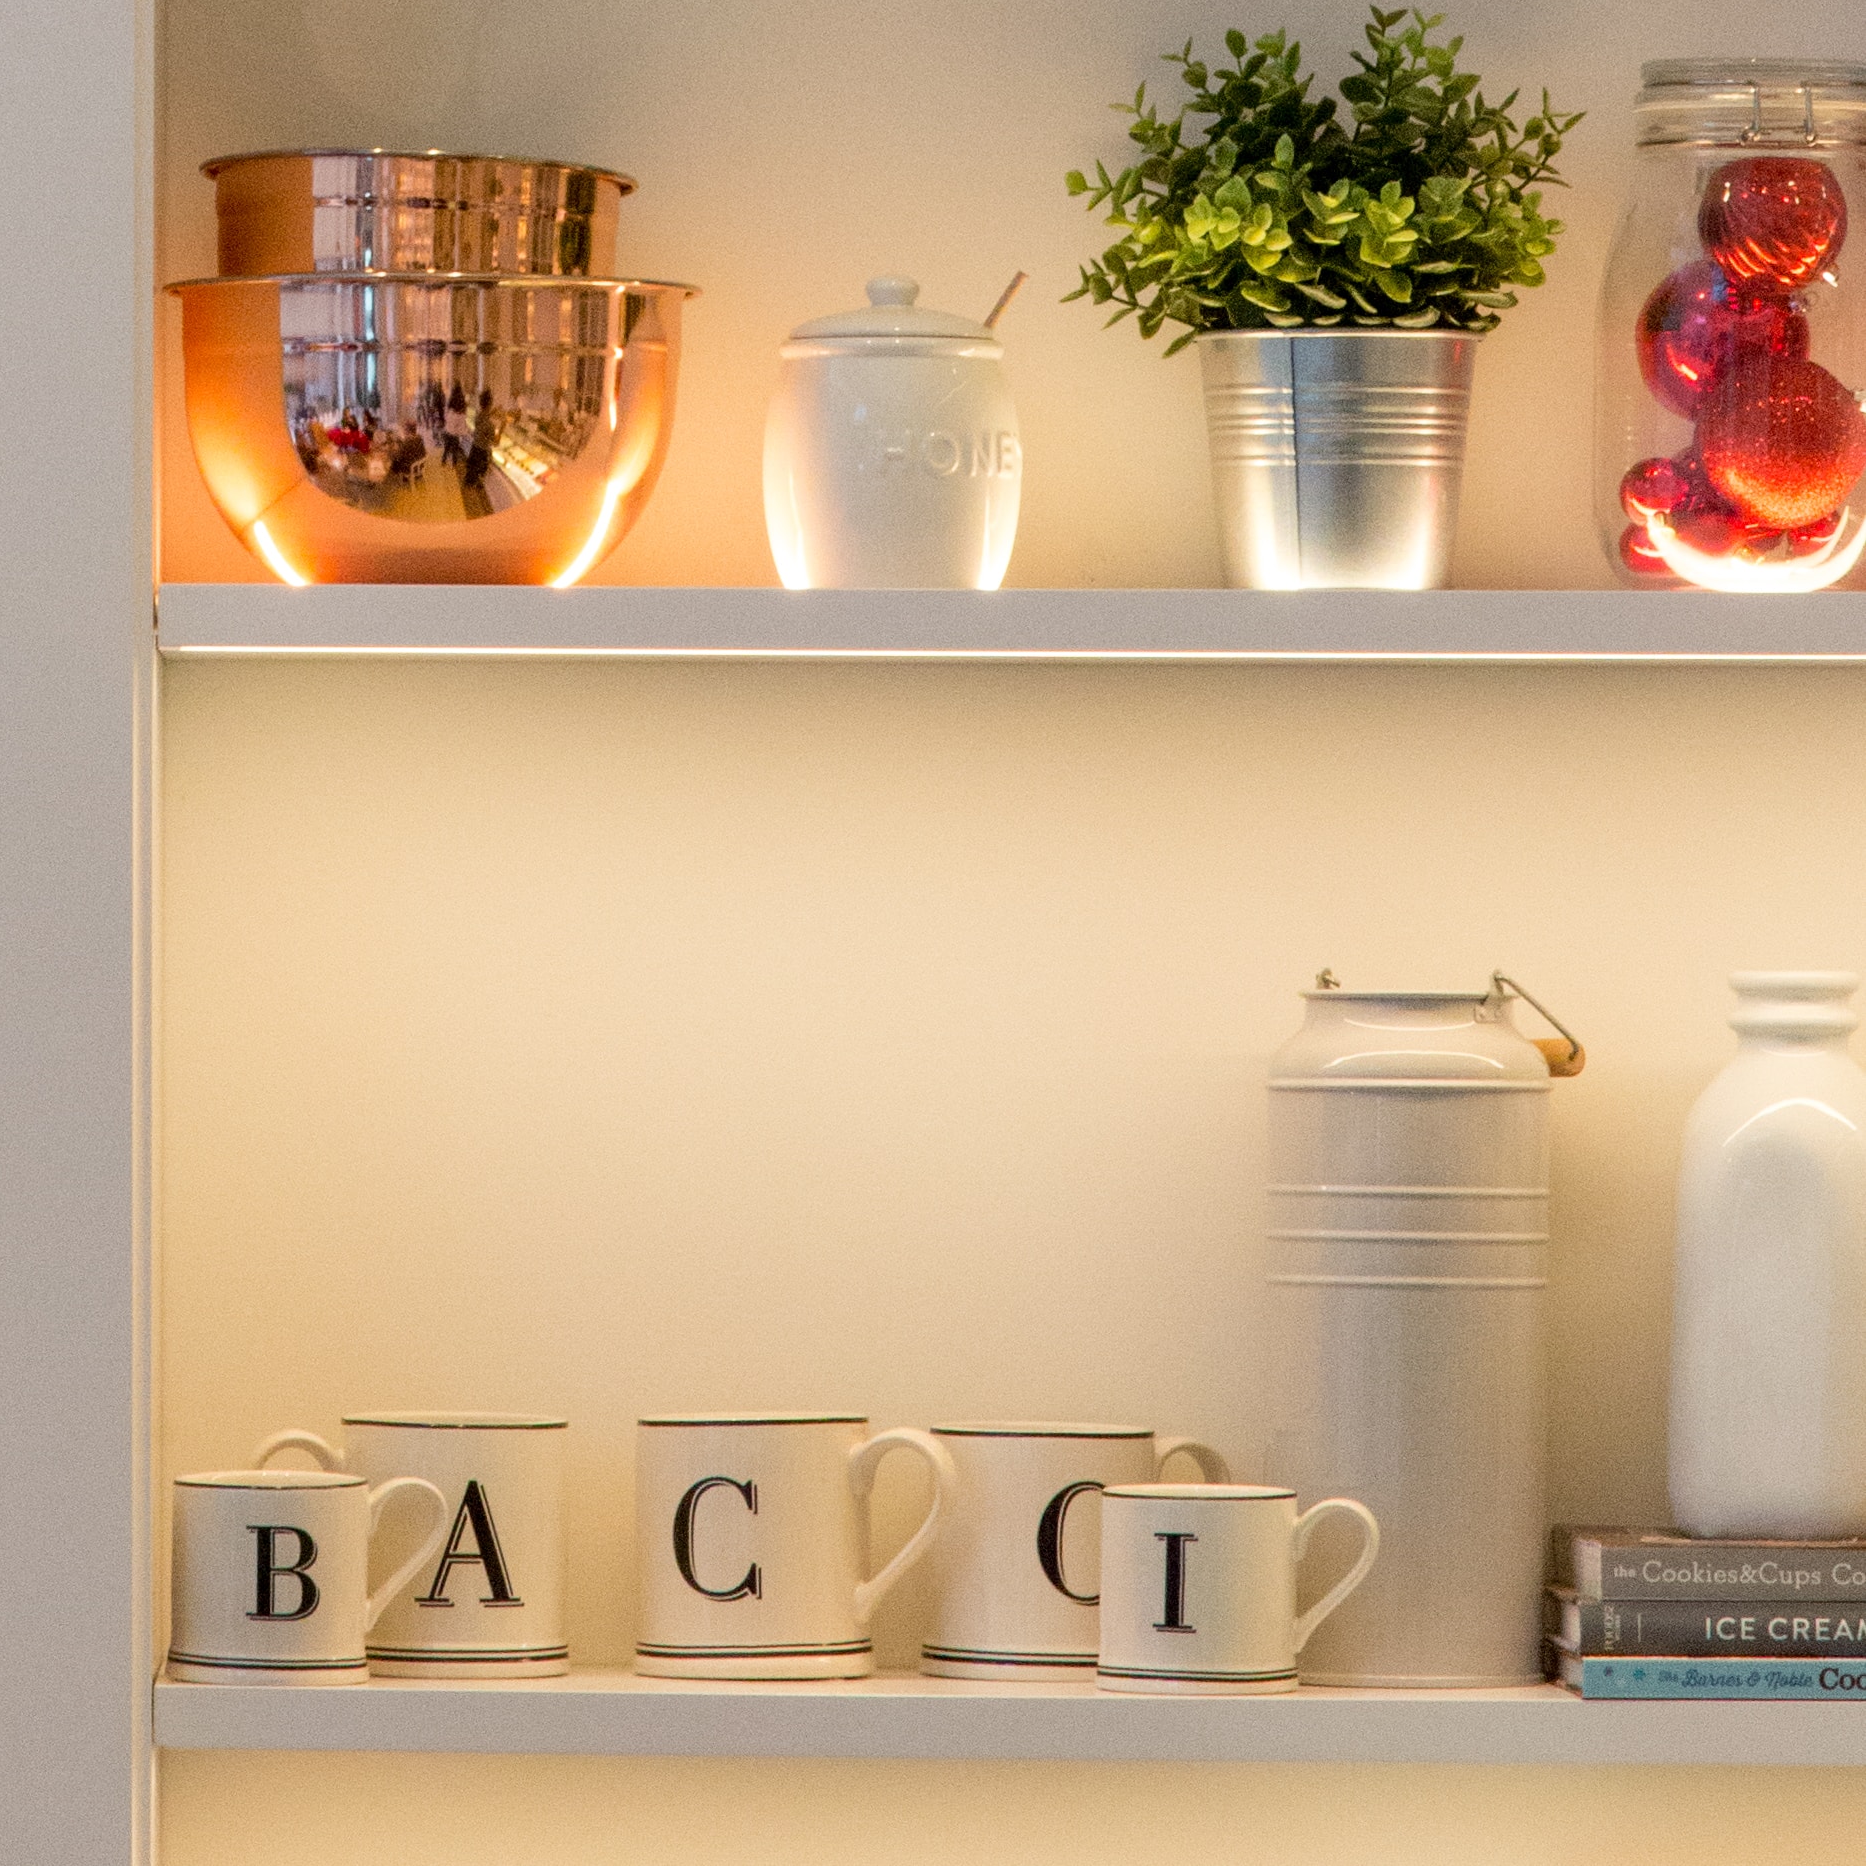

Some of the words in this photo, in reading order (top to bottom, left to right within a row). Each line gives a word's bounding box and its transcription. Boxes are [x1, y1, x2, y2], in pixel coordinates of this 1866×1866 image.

[245, 1524, 320, 1621] B
[414, 1479, 525, 1607] A
[672, 1475, 762, 1602] C
[1152, 1531, 1199, 1634] I
[1705, 1616, 1756, 1641] ICE
